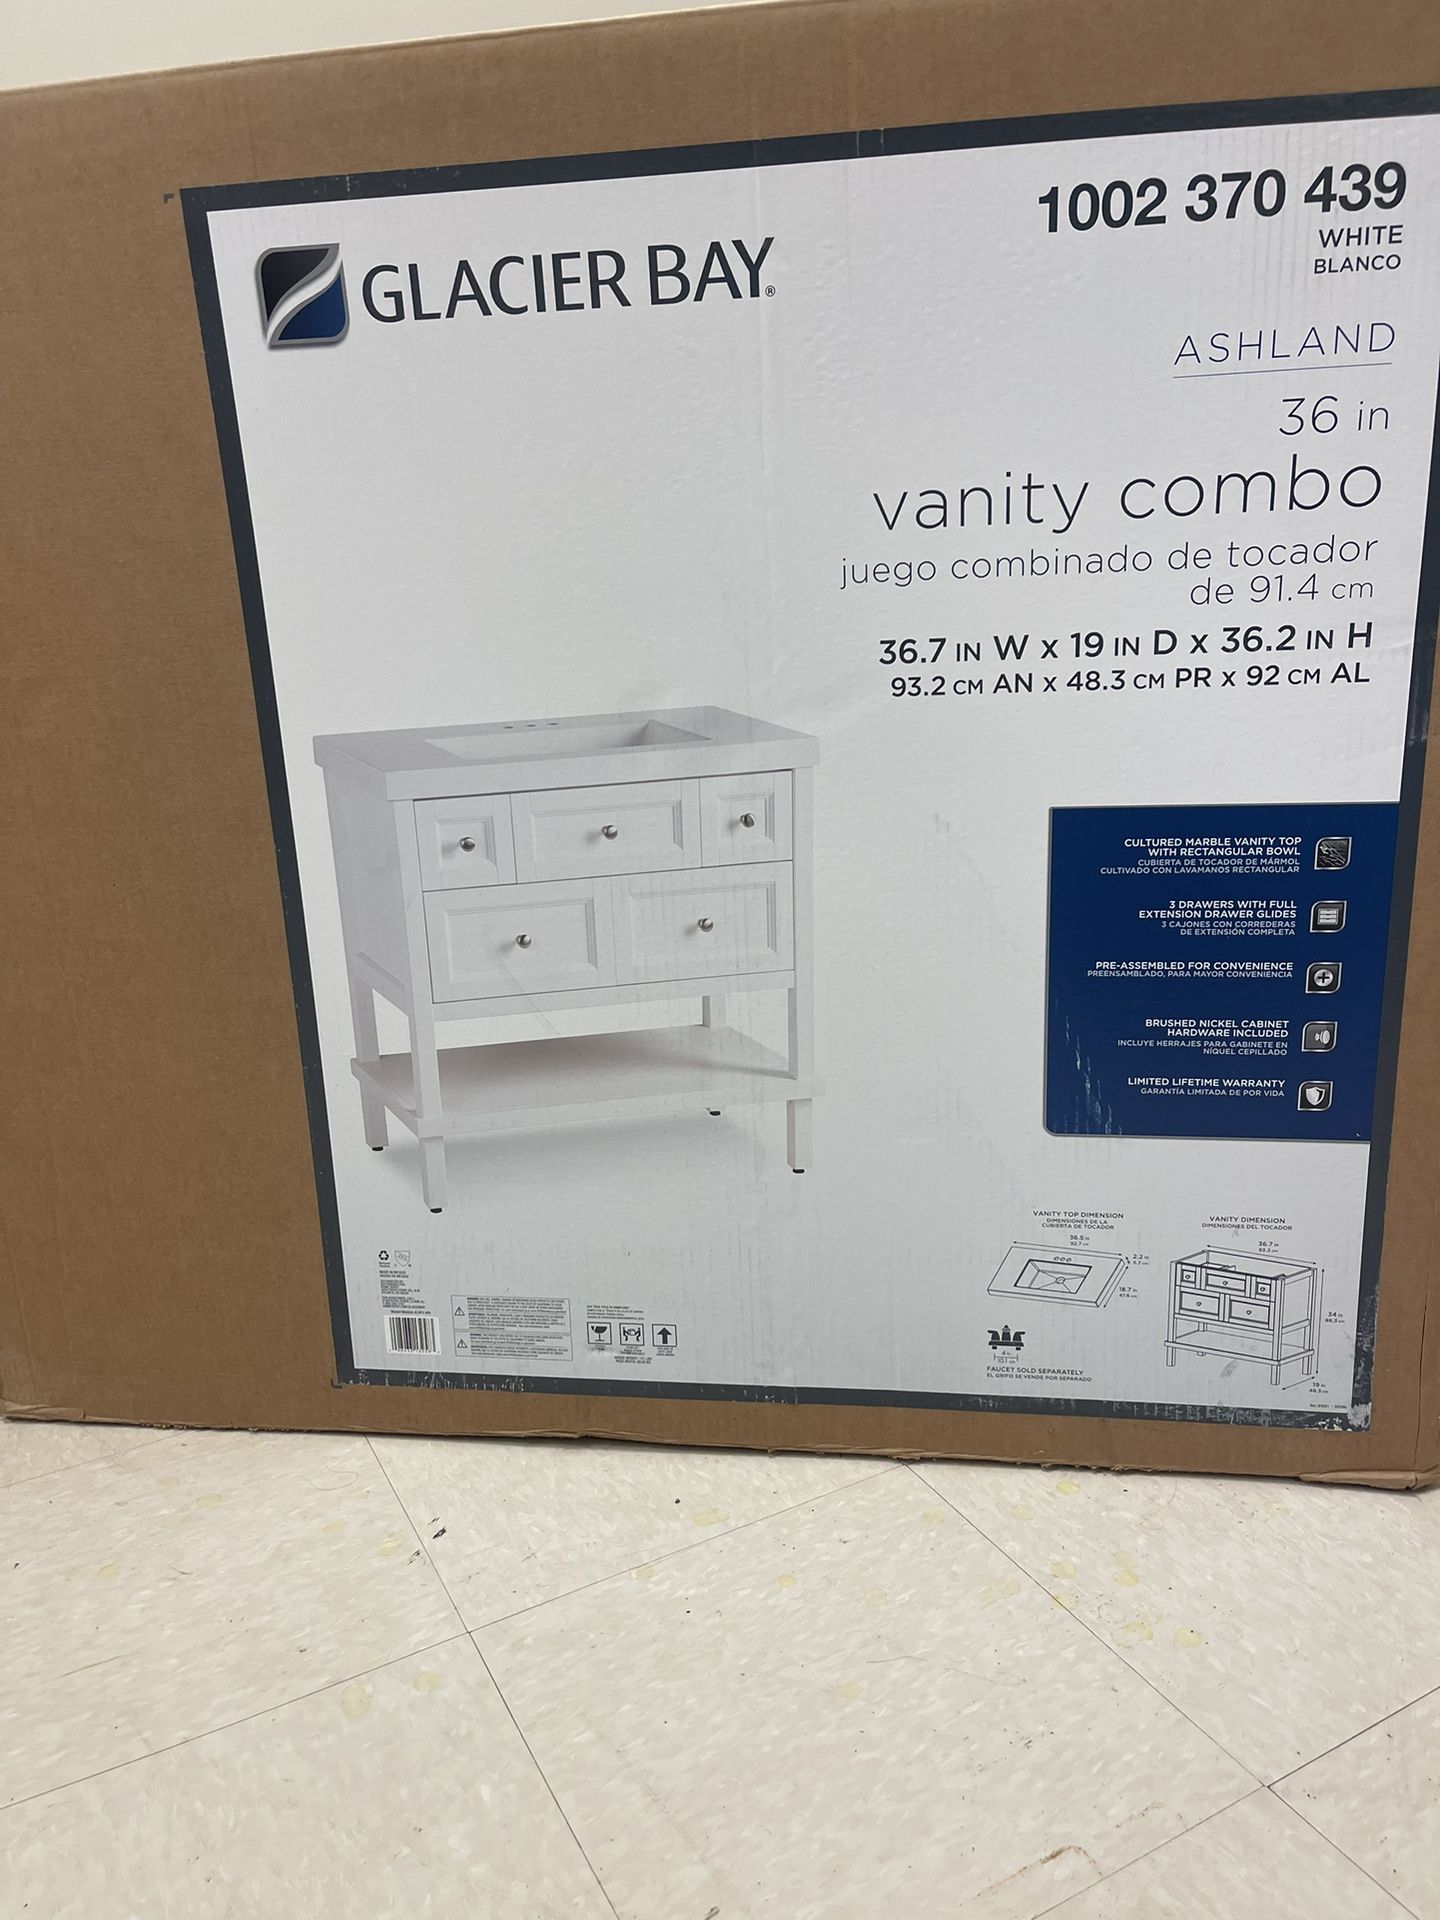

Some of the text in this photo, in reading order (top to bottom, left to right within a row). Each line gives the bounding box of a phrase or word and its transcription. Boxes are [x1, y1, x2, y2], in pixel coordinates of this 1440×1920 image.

[1038, 161, 1407, 233] 1002 370 439
[1318, 224, 1404, 250] WHITE
[1313, 253, 1402, 275] BLANCO
[362, 250, 631, 323] GLACIER
[1174, 321, 1396, 366] ASHLAND
[1278, 395, 1389, 436] 36 in
[873, 453, 1382, 534] vanity combo
[840, 534, 1379, 590] juego combinado de tocador
[1190, 574, 1373, 606] de 91.4 cm
[879, 638, 946, 666] 36.7
[955, 642, 981, 662] IN
[993, 634, 1030, 660] W
[1070, 631, 1104, 658] 19
[1113, 636, 1140, 656] IN
[1153, 629, 1177, 655] D
[1221, 624, 1296, 653] 36.2
[1306, 628, 1334, 649] IN
[1347, 622, 1373, 648] H
[890, 675, 946, 698] 93.2
[953, 678, 984, 695] CM
[992, 672, 1033, 694] AN
[1066, 670, 1127, 692] 48.3
[1132, 672, 1165, 690] CM
[1175, 667, 1212, 689] PR
[1246, 664, 1280, 686] 92
[1287, 667, 1321, 684] CM
[1330, 661, 1370, 683] AL
[1124, 837, 1301, 847] CULTURED MARBLE VANITY TOP
[1148, 847, 1301, 856] WITH RECTANGULAR BOWL
[1260, 857, 1300, 865] MÁRMOL
[1169, 900, 1297, 909] 3 DRAWERS WITH FULL
[1139, 910, 1296, 918] EXTENSION DRAWER GLIDES
[1195, 927, 1245, 935] EXTENSIÓN
[1096, 961, 1293, 970] PRE-ASSEMBLED FOR CONVENIENCE
[1145, 1019, 1289, 1028] BRUSHED NICKEL CABINET
[1167, 1028, 1288, 1038] HARDWARE INCLUDED
[1203, 1047, 1236, 1055] NÍQUEL
[1128, 1078, 1285, 1088] LIMITED LIFETIME WARRANTY
